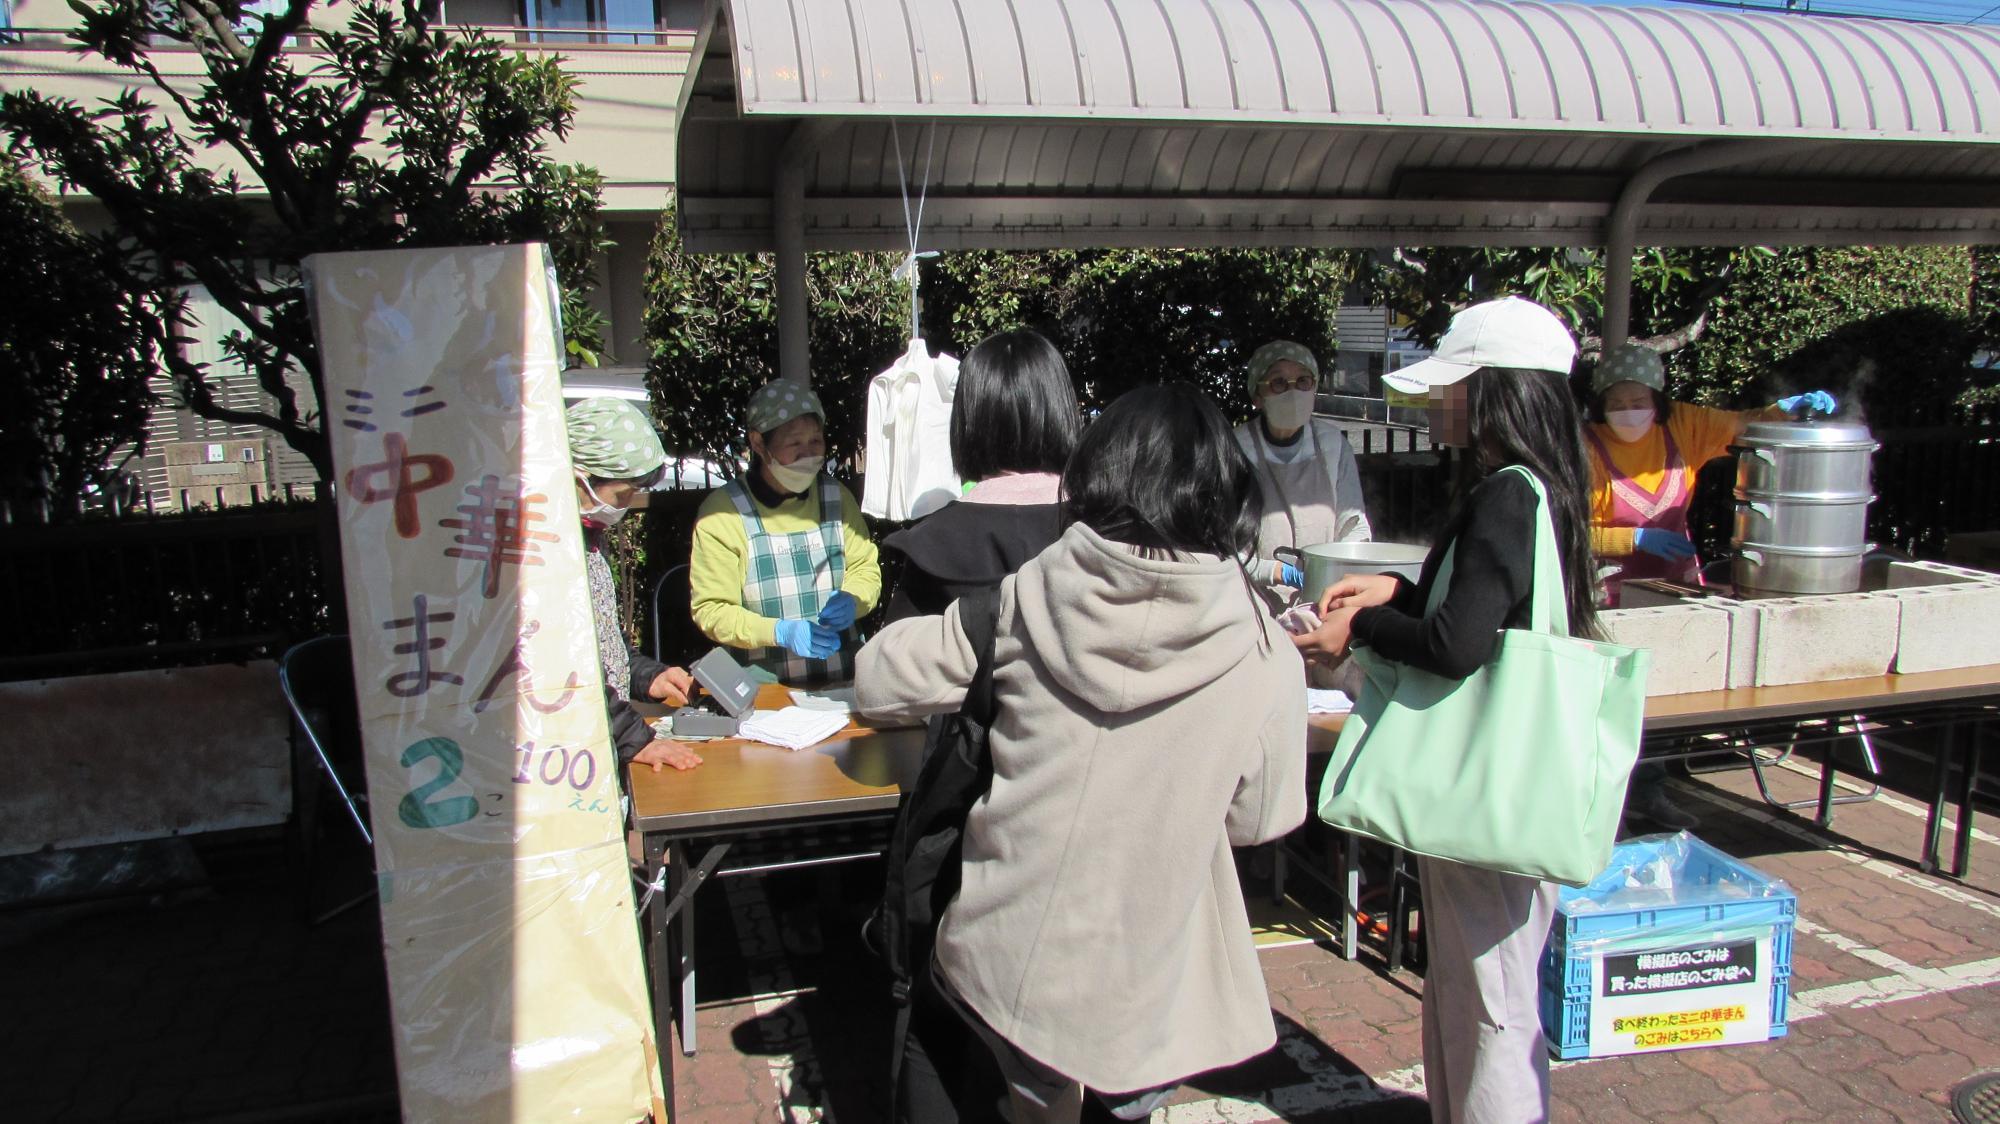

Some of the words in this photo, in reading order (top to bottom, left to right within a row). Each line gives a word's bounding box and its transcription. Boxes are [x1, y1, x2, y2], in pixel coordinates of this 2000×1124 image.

[511, 740, 596, 790] 100
[1637, 948, 1730, 970] 模擬店のごみは
[1613, 1006, 1745, 1032] 食べ終わったミニ中華まん
[1634, 1026, 1723, 1046] のごみはこちらへ
